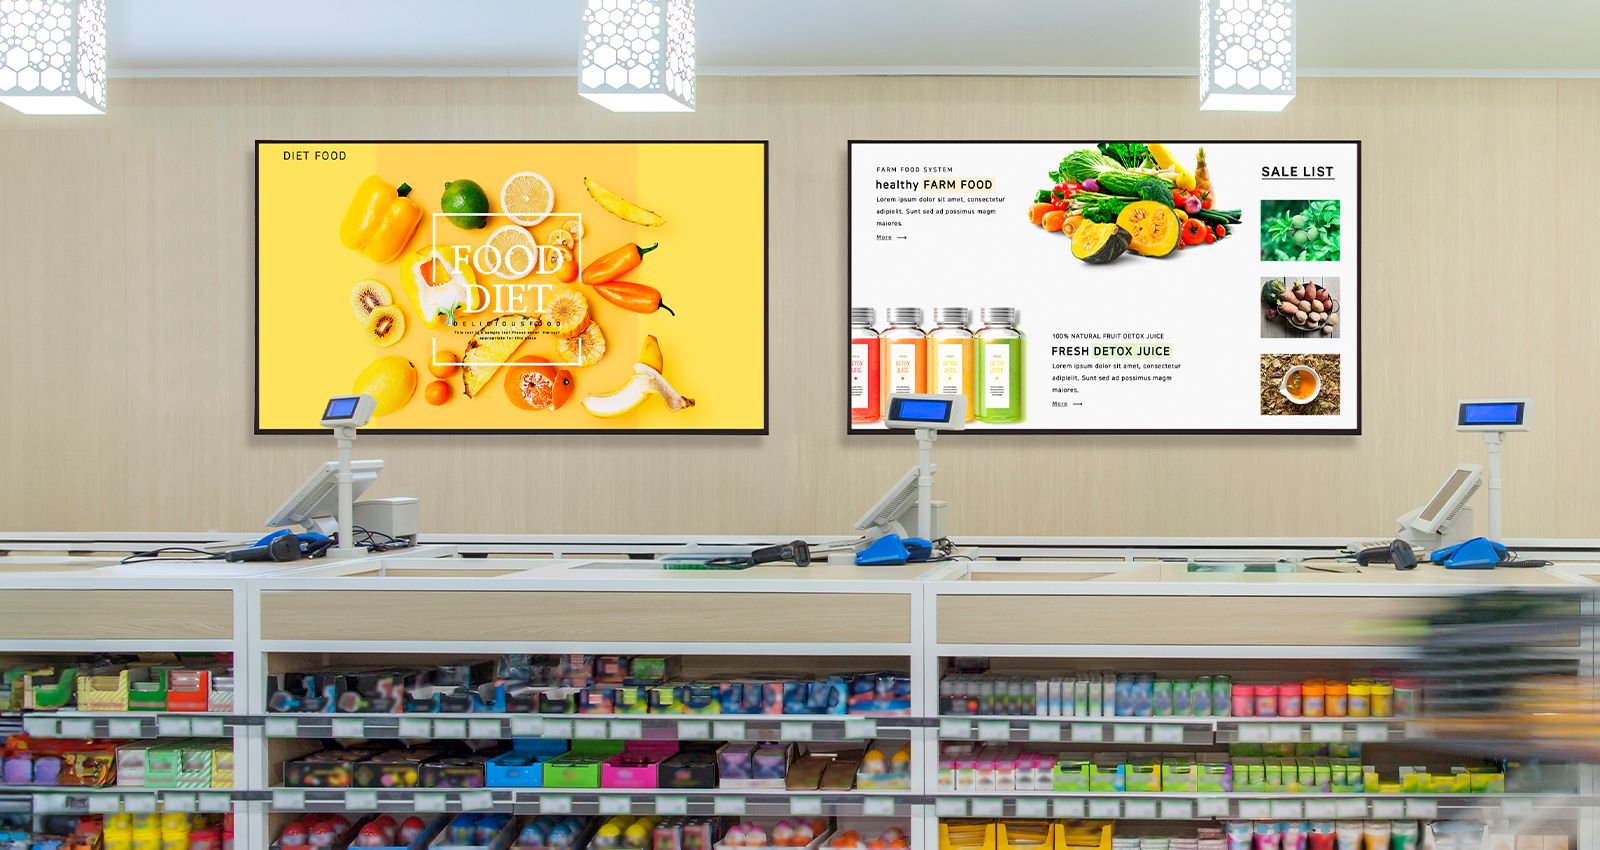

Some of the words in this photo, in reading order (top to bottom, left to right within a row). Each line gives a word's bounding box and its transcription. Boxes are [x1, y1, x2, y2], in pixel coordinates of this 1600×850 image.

[283, 151, 309, 160] DIET
[315, 151, 346, 160] FOOD
[1261, 166, 1298, 177] SALE
[1303, 166, 1334, 177] LIST
[875, 180, 919, 191] healthy
[923, 180, 956, 190] FARM
[960, 180, 993, 190] FOOD
[945, 208, 975, 216] possimus
[451, 245, 564, 275] FOOD
[463, 284, 552, 313] DIET
[1051, 346, 1089, 356] FRESH
[1093, 346, 1133, 356] DETOX
[1136, 346, 1170, 356] JUICE
